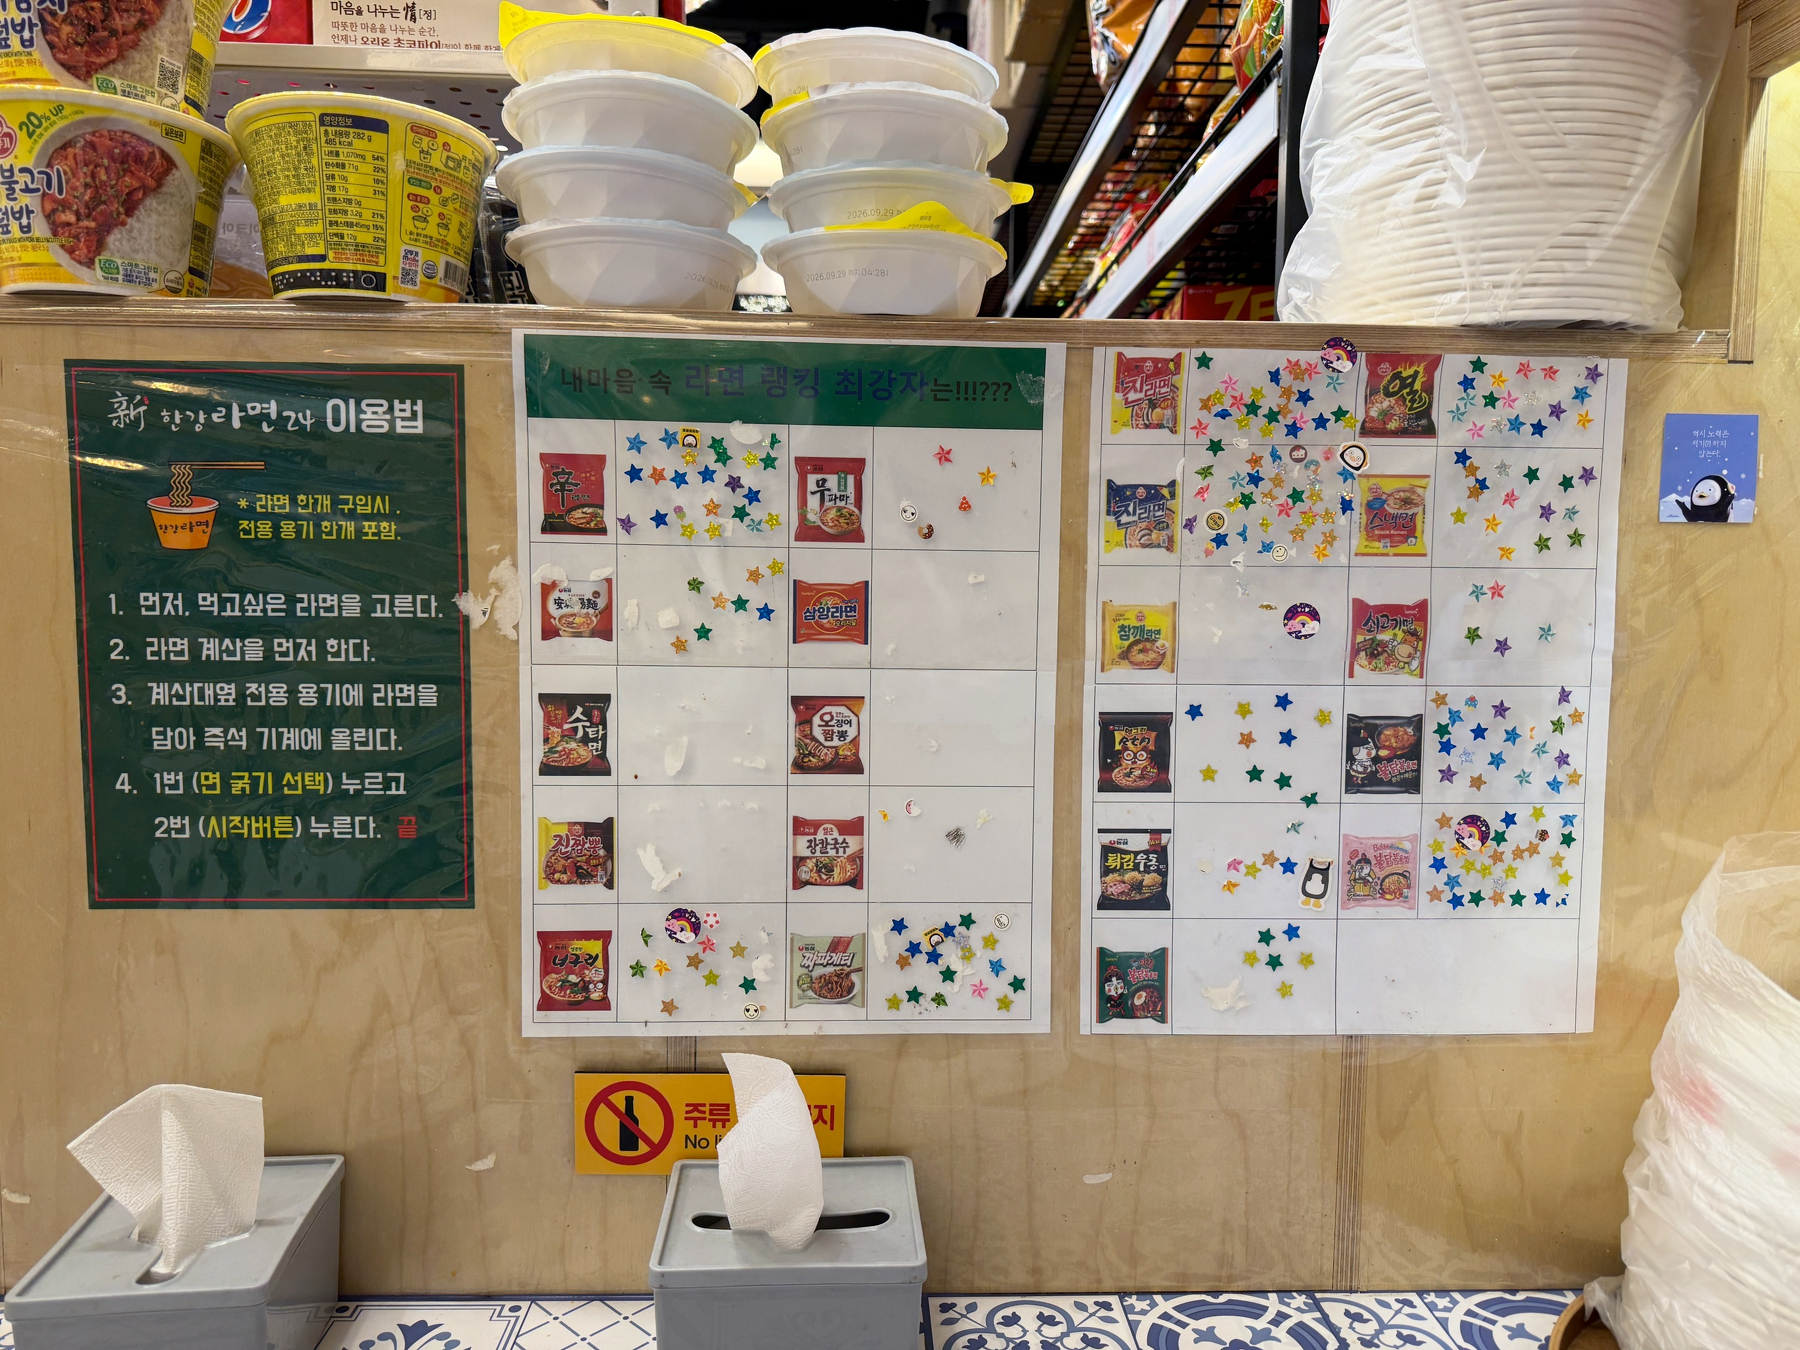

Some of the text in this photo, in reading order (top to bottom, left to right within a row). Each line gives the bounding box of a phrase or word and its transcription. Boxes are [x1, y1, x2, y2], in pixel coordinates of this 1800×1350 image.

[331, 1, 364, 17] 마음을
[367, 5, 401, 19] 나누는
[332, 21, 358, 32] 따뜻한
[361, 23, 386, 34] 마음을
[390, 24, 415, 36] 나누는
[331, 34, 358, 45] 언제나
[361, 36, 390, 47] 오리온
[98, 79, 115, 88] ECO
[19, 111, 51, 140] 20%
[49, 104, 65, 117] UP
[323, 116, 353, 126] 영양정보
[324, 138, 354, 147] 485 kcal
[331, 129, 351, 139] 내용량
[352, 131, 366, 140] 282
[342, 151, 367, 161] 1,070mg
[372, 154, 386, 162] 54%
[347, 163, 359, 171] 71g
[372, 166, 386, 174] 22%
[0, 164, 65, 202] 불고기
[338, 174, 348, 182] 10g
[373, 178, 386, 186] 10%
[338, 185, 349, 193] 17g
[372, 189, 386, 197] 31%
[349, 209, 363, 218] 3.2g
[371, 212, 385, 220] 21%
[847, 208, 894, 220] 2026.09.29
[346, 233, 357, 241] 12g
[372, 224, 385, 232] 15%
[100, 260, 117, 268] ECO
[120, 261, 158, 274] 스마트그린컵
[806, 269, 847, 282] 2026.09.29
[560, 366, 640, 395] 내마음
[648, 368, 672, 396] 속
[686, 365, 746, 397] 라면
[760, 366, 821, 398] 랭킹
[1122, 374, 1173, 408] 진라면
[107, 391, 149, 433] 新
[326, 397, 424, 434] 이용법
[549, 467, 581, 509] 辛
[810, 477, 850, 506] 무파마
[256, 494, 290, 514] 라면
[297, 494, 331, 514] 한개
[1113, 499, 1168, 531] 진라면
[1367, 511, 1415, 530] 스낵면
[238, 521, 401, 541] 전용 용기 한개 포함.
[109, 593, 125, 617] 1.
[198, 592, 287, 618] 먹고싶은
[295, 593, 362, 618] 라면을
[370, 594, 444, 619] 고른다.
[802, 604, 858, 622] 삼양라면
[1361, 610, 1415, 635] 쇠고기면
[1117, 623, 1162, 643] 참깨라면
[109, 638, 376, 662] 2. 라면 계산을 먼저 한다.
[111, 682, 439, 707] 3. 계산대옆 전용 용기에 라면을
[817, 711, 853, 728] 오징어
[151, 727, 403, 752] 담아 즉석 기계에 올린다.
[563, 705, 606, 755] 수타면
[821, 728, 850, 743] 짬뽕
[1376, 759, 1419, 783] 불닭볶음면
[115, 773, 138, 795] 4.
[153, 772, 184, 795] 1번
[230, 773, 273, 795] 굵기
[282, 773, 334, 796] 선택)
[341, 773, 407, 796] 누르고
[154, 815, 418, 840] 2번 (시작버튼) 누른다. 끝
[550, 832, 603, 857] 진짬뽕
[806, 837, 850, 855] 장칼국수
[552, 952, 600, 969] 너구리
[799, 951, 857, 973] 짜파게티
[684, 1102, 731, 1129] 주류
[684, 1134, 710, 1149] No
